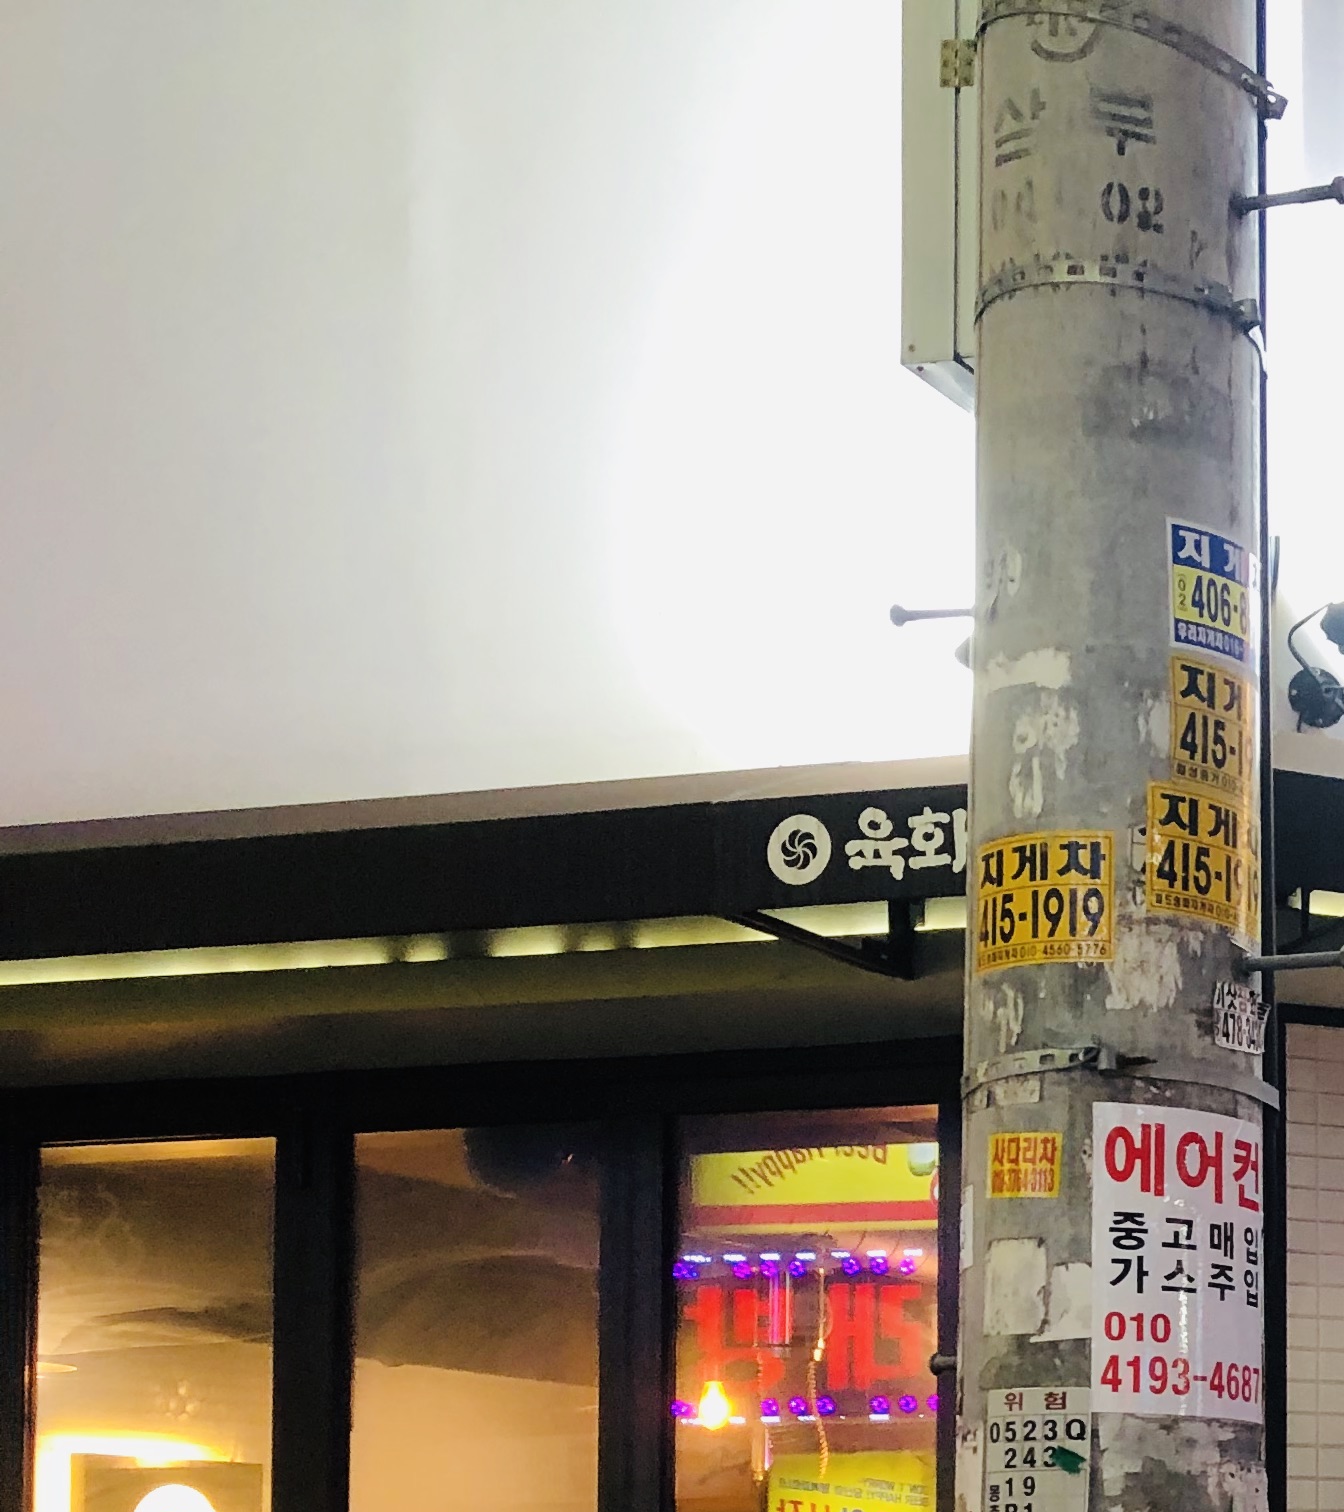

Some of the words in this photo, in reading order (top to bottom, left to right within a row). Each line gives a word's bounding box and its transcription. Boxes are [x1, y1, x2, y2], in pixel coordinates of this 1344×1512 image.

[981, 840, 1106, 889] 지게차
[980, 887, 1105, 949] 415-1919
[992, 1136, 1057, 1167] 사다리차
[1104, 1123, 1259, 1212] 에어컨
[1104, 1312, 1171, 1343] 010
[1101, 1355, 1260, 1404] 4193-4687
